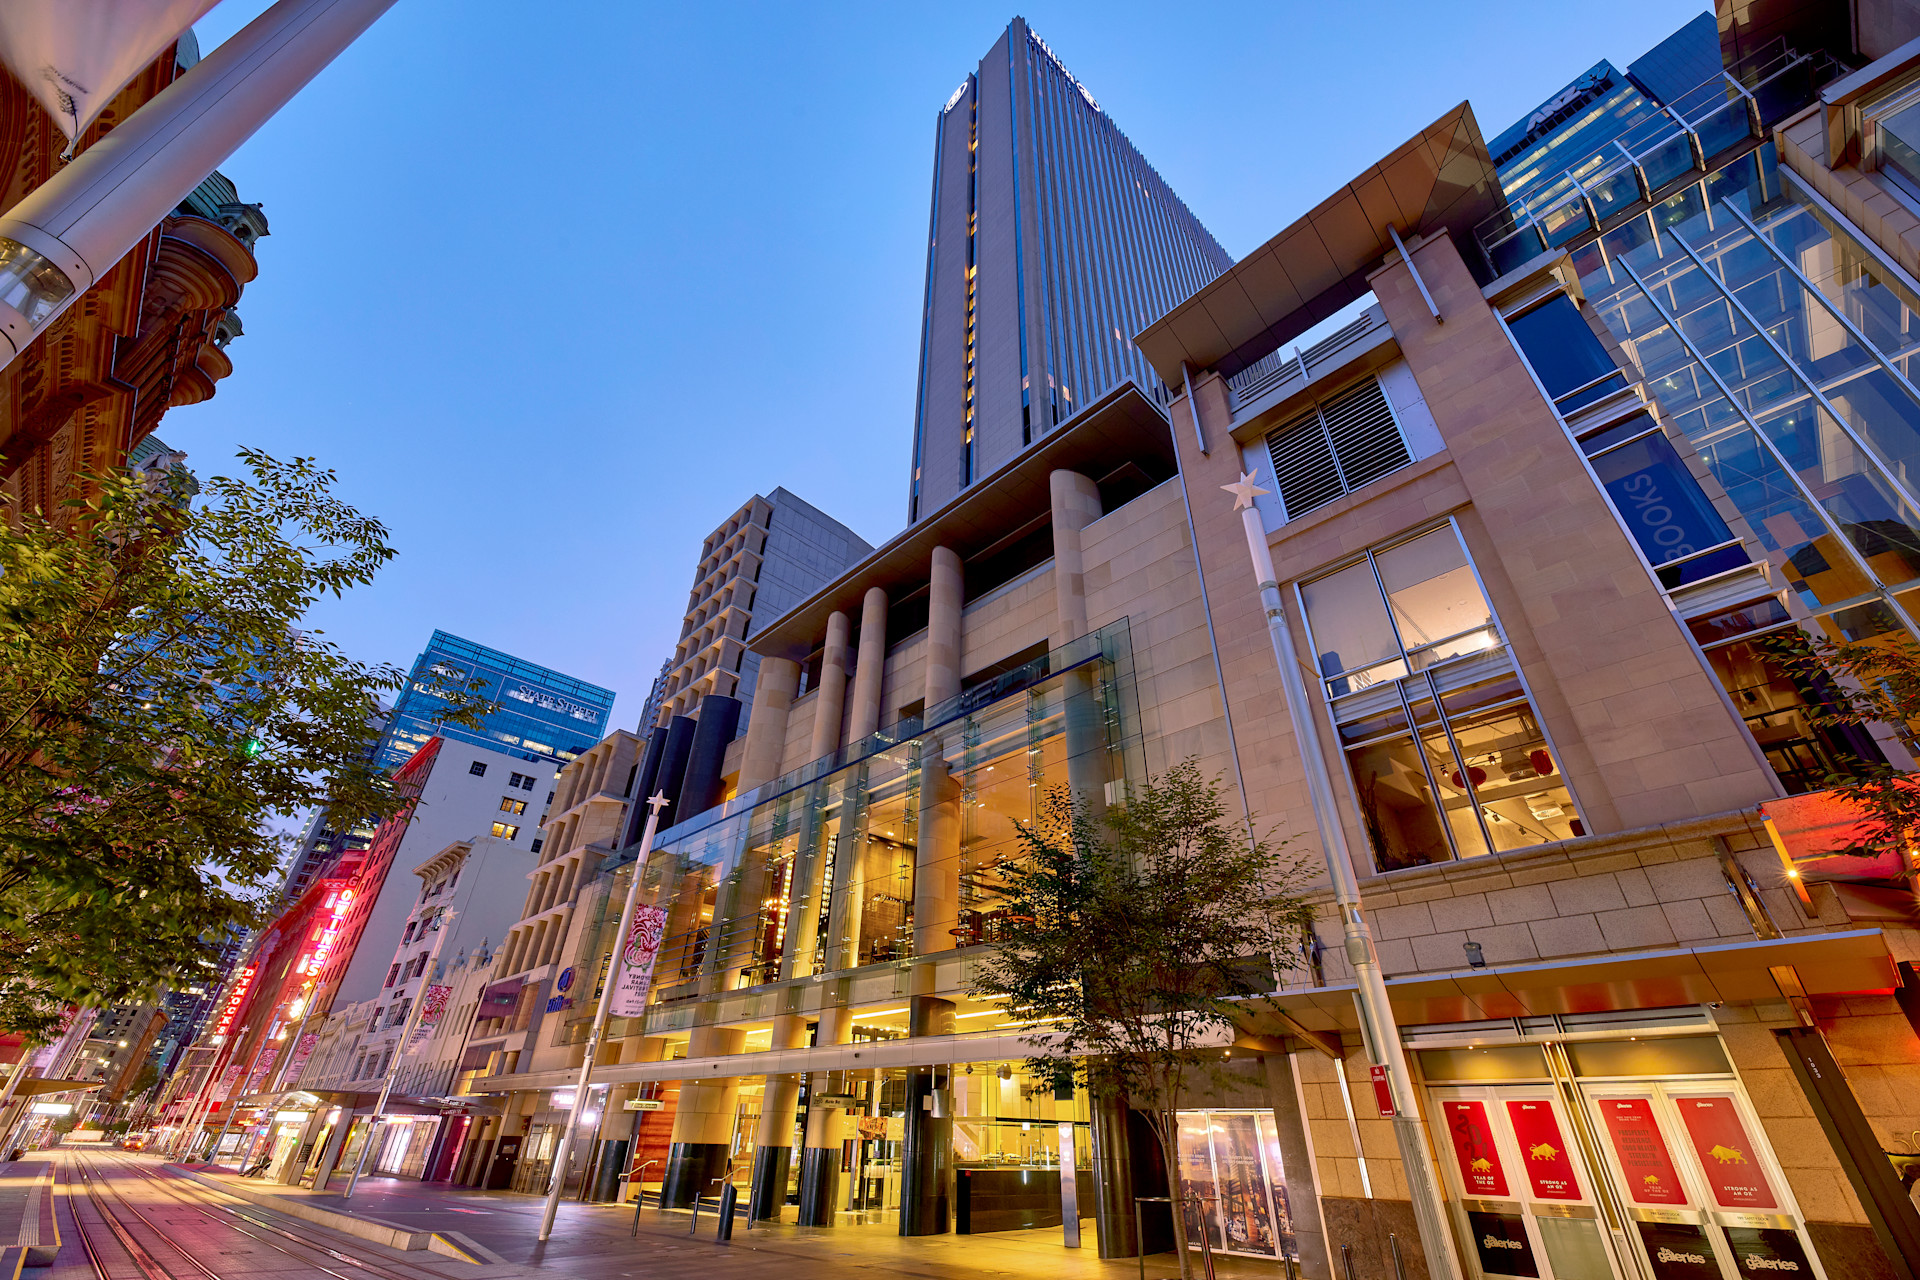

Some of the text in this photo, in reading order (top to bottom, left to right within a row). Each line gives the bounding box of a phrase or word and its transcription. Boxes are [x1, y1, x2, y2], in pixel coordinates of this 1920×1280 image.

[1526, 86, 1582, 133] ANZ
[1623, 473, 1696, 562] BOOKS
[519, 685, 600, 720] STATE STREET
[306, 876, 359, 977] GOWINGS
[217, 967, 255, 1034] DYMOCKS
[545, 994, 574, 1013] Hilton
[1484, 1238, 1522, 1250] galeries
[1657, 1251, 1706, 1264] galeries
[1746, 1258, 1799, 1270] galeries
